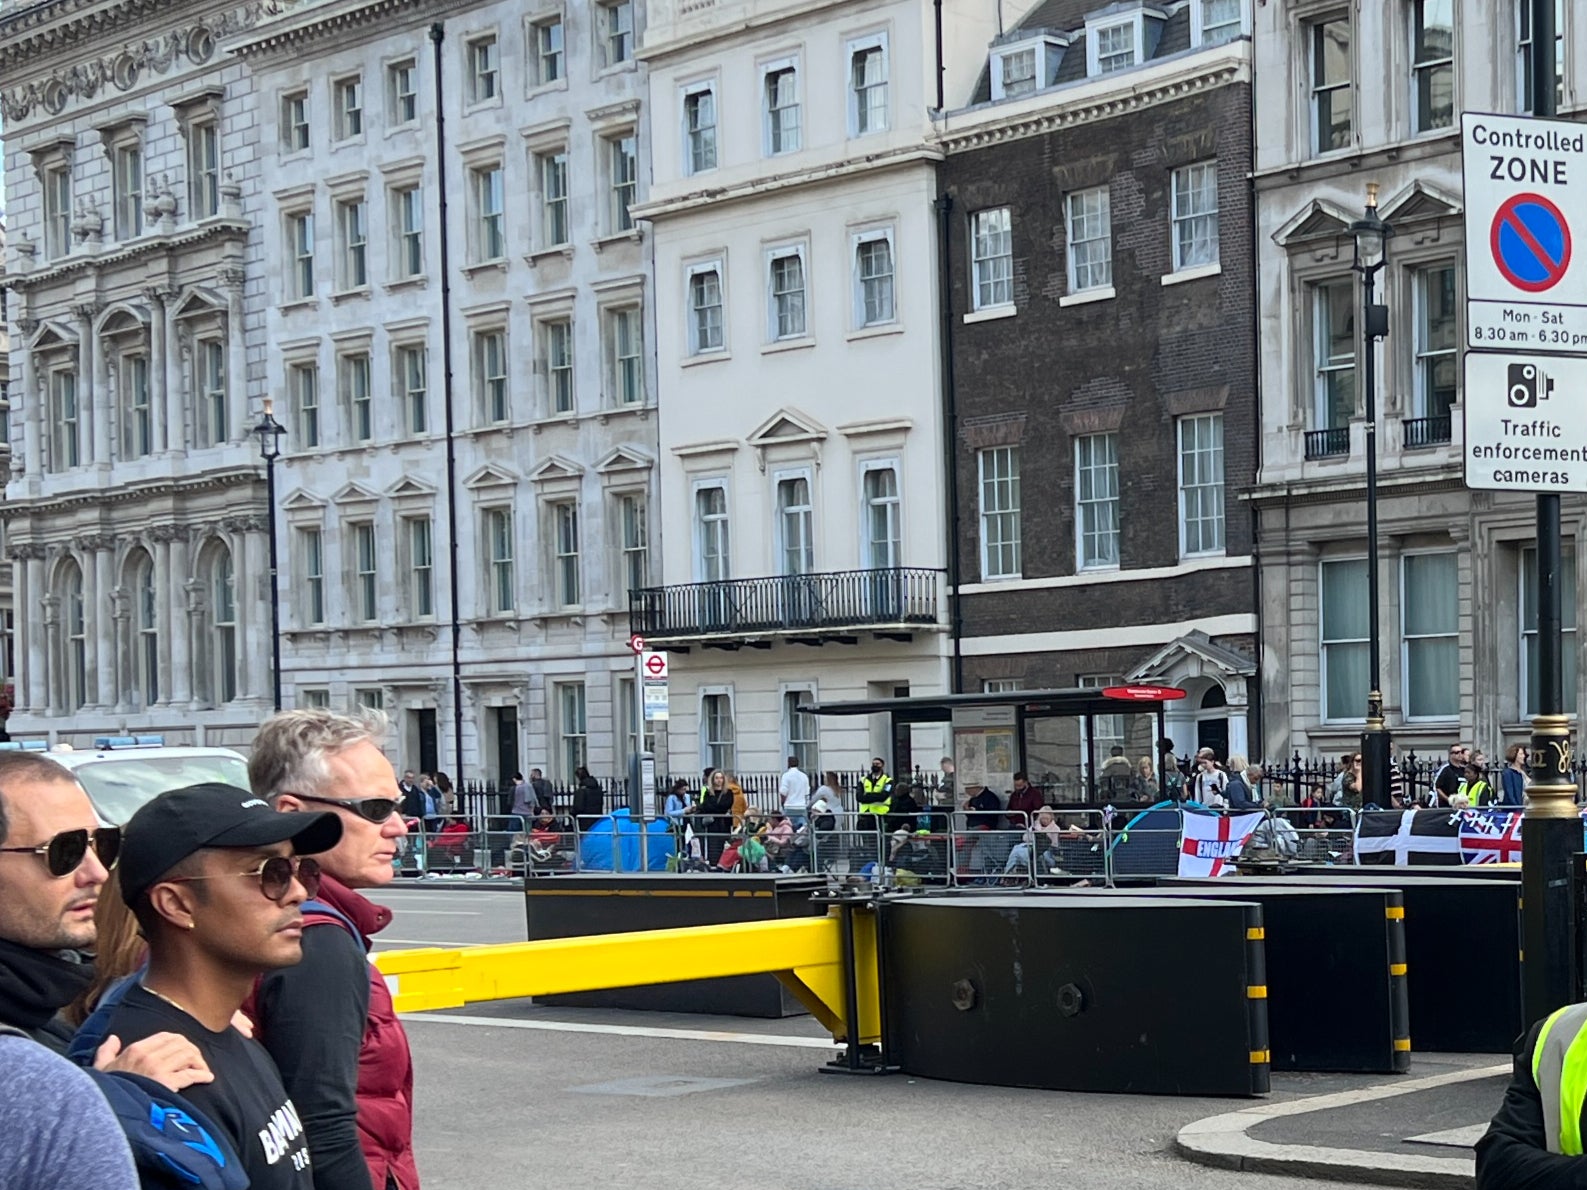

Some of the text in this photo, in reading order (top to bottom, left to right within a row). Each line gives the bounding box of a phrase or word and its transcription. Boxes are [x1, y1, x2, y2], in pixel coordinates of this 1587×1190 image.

[1472, 124, 1584, 153] Controlled
[1490, 155, 1568, 185] ZONE
[1502, 309, 1531, 323] Mon
[1541, 311, 1564, 325] Sat
[1474, 326, 1506, 341] 8.30
[1509, 331, 1528, 342] am
[1538, 329, 1569, 344] 6.30
[1500, 419, 1561, 438] Traffic
[1493, 469, 1569, 485] cameras
[633, 637, 644, 650] G
